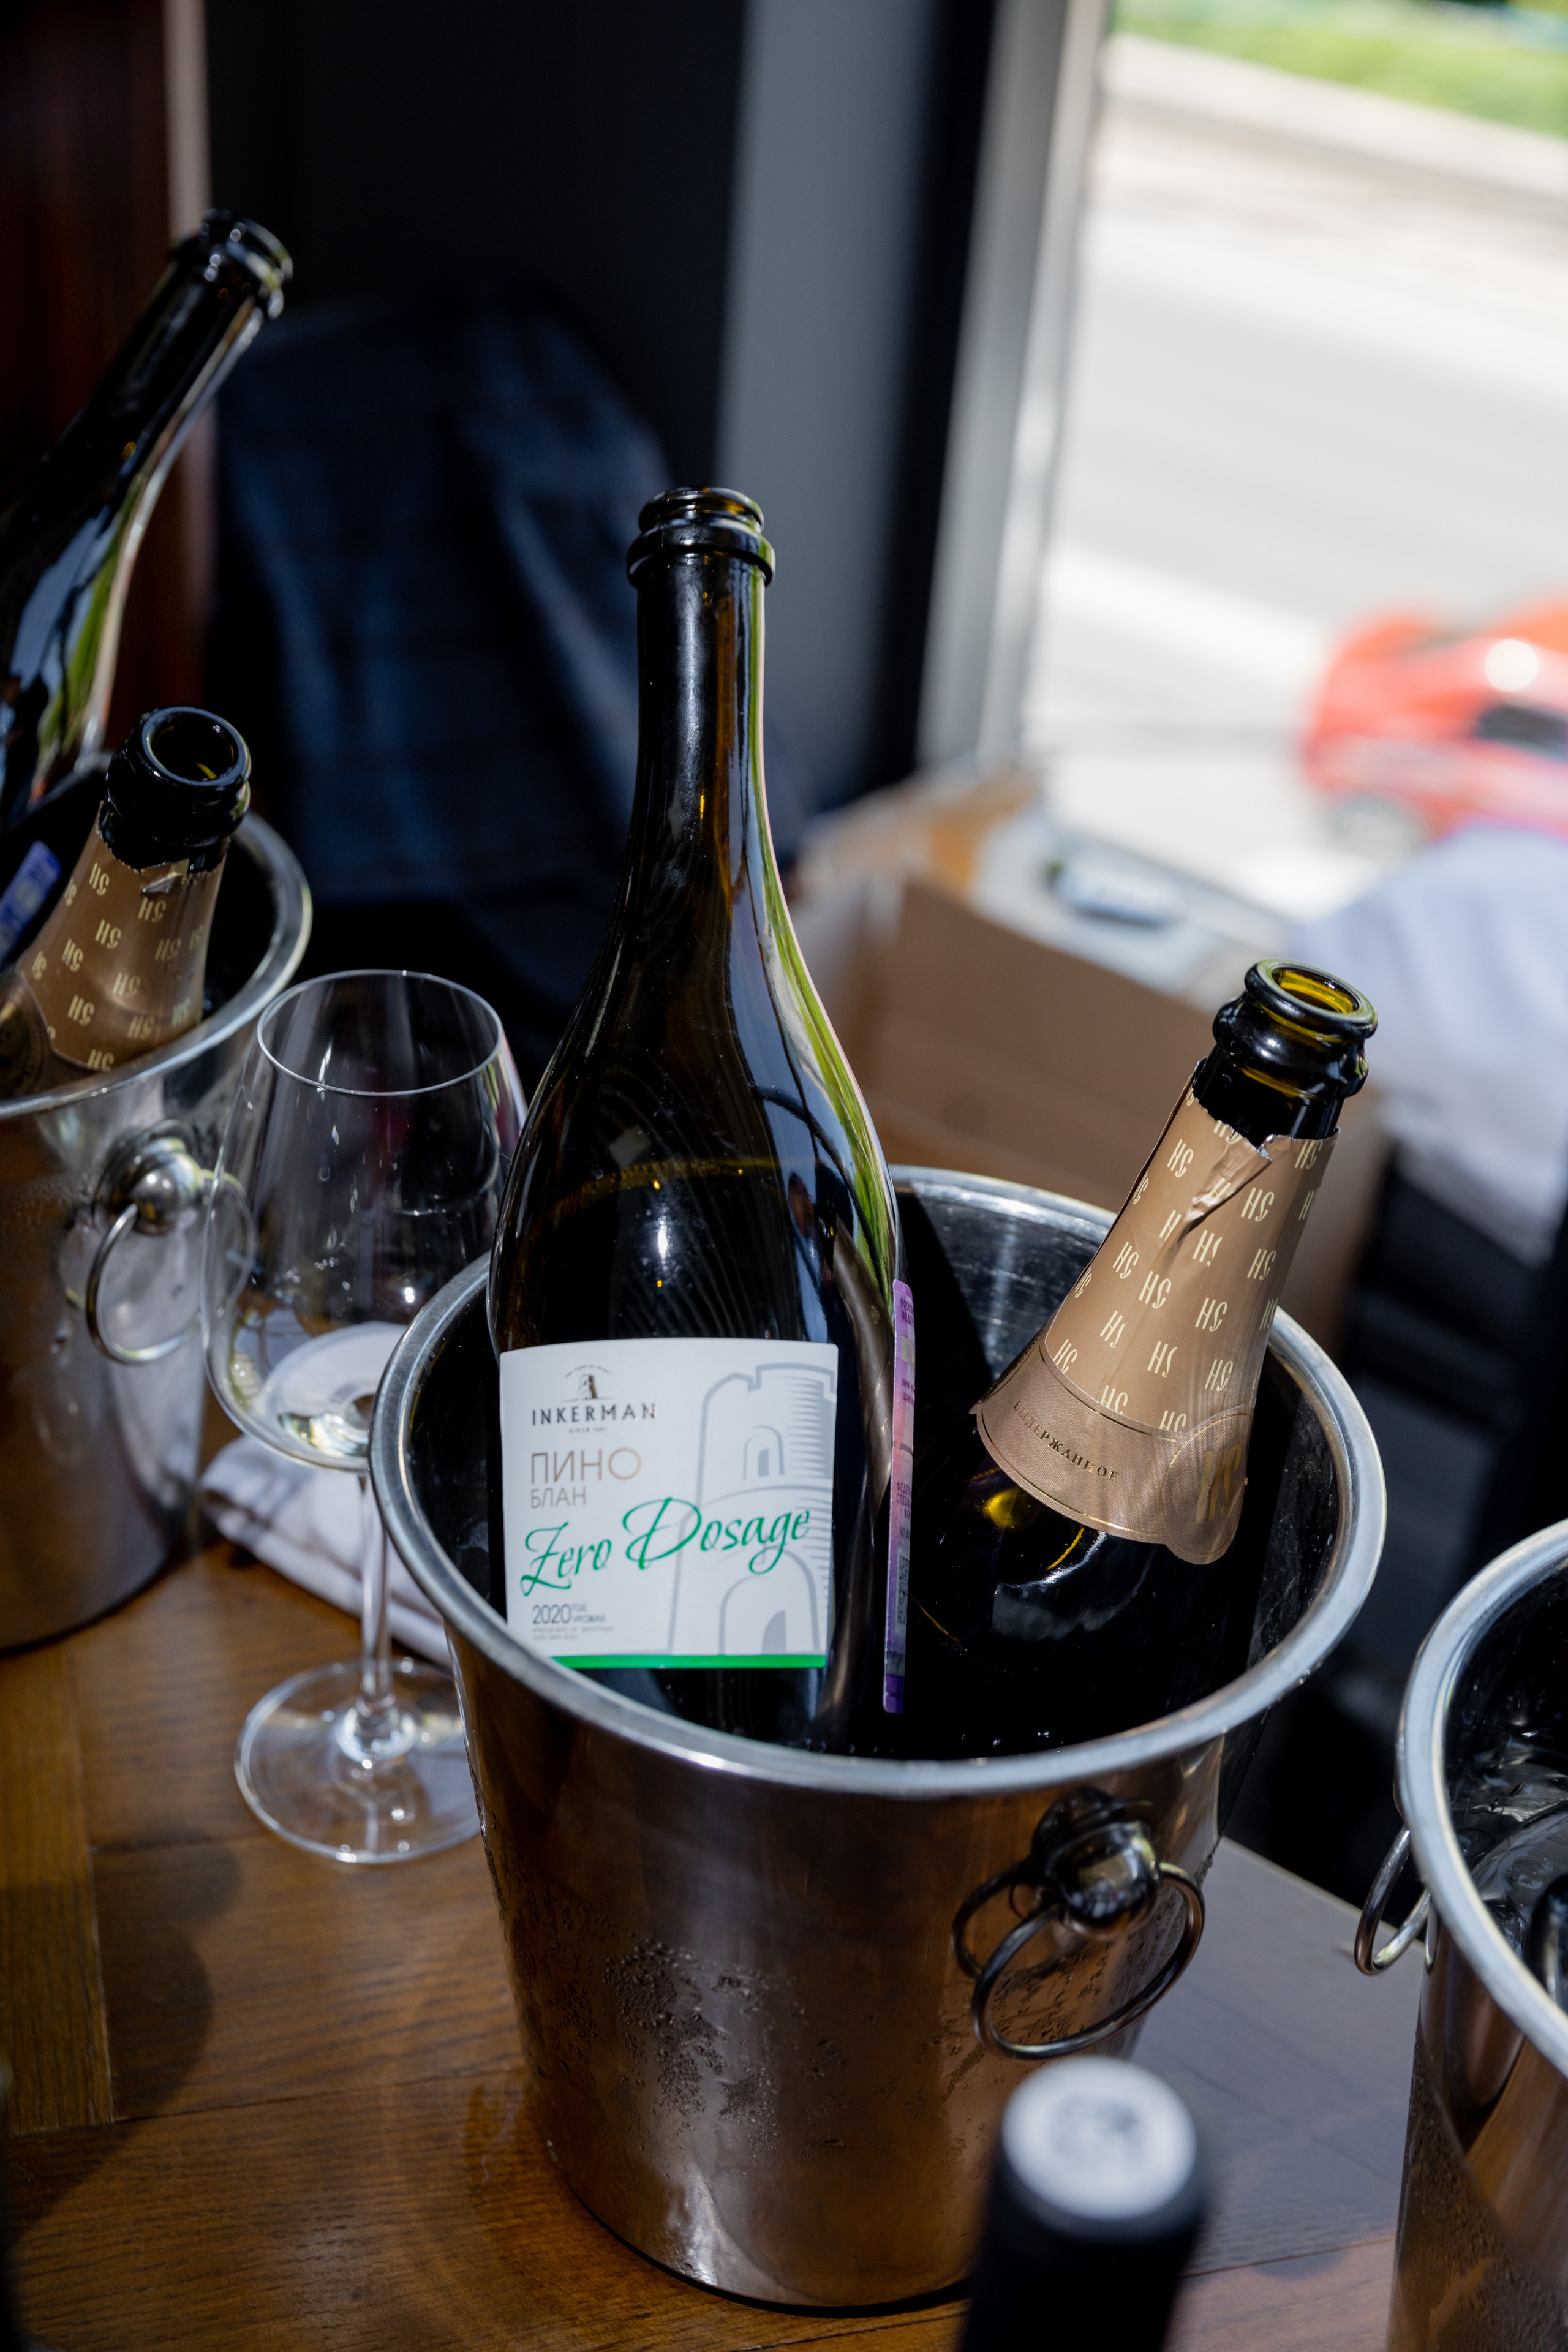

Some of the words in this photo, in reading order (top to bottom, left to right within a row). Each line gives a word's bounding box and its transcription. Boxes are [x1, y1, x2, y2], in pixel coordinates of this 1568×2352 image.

[532, 1403, 657, 1426] INKERMAN
[532, 1447, 641, 1484] ПИНО
[531, 1486, 586, 1509] БЛАН
[520, 1521, 611, 1596] Zero
[622, 1497, 810, 1575] Dosage
[532, 1604, 572, 1624] 2020
